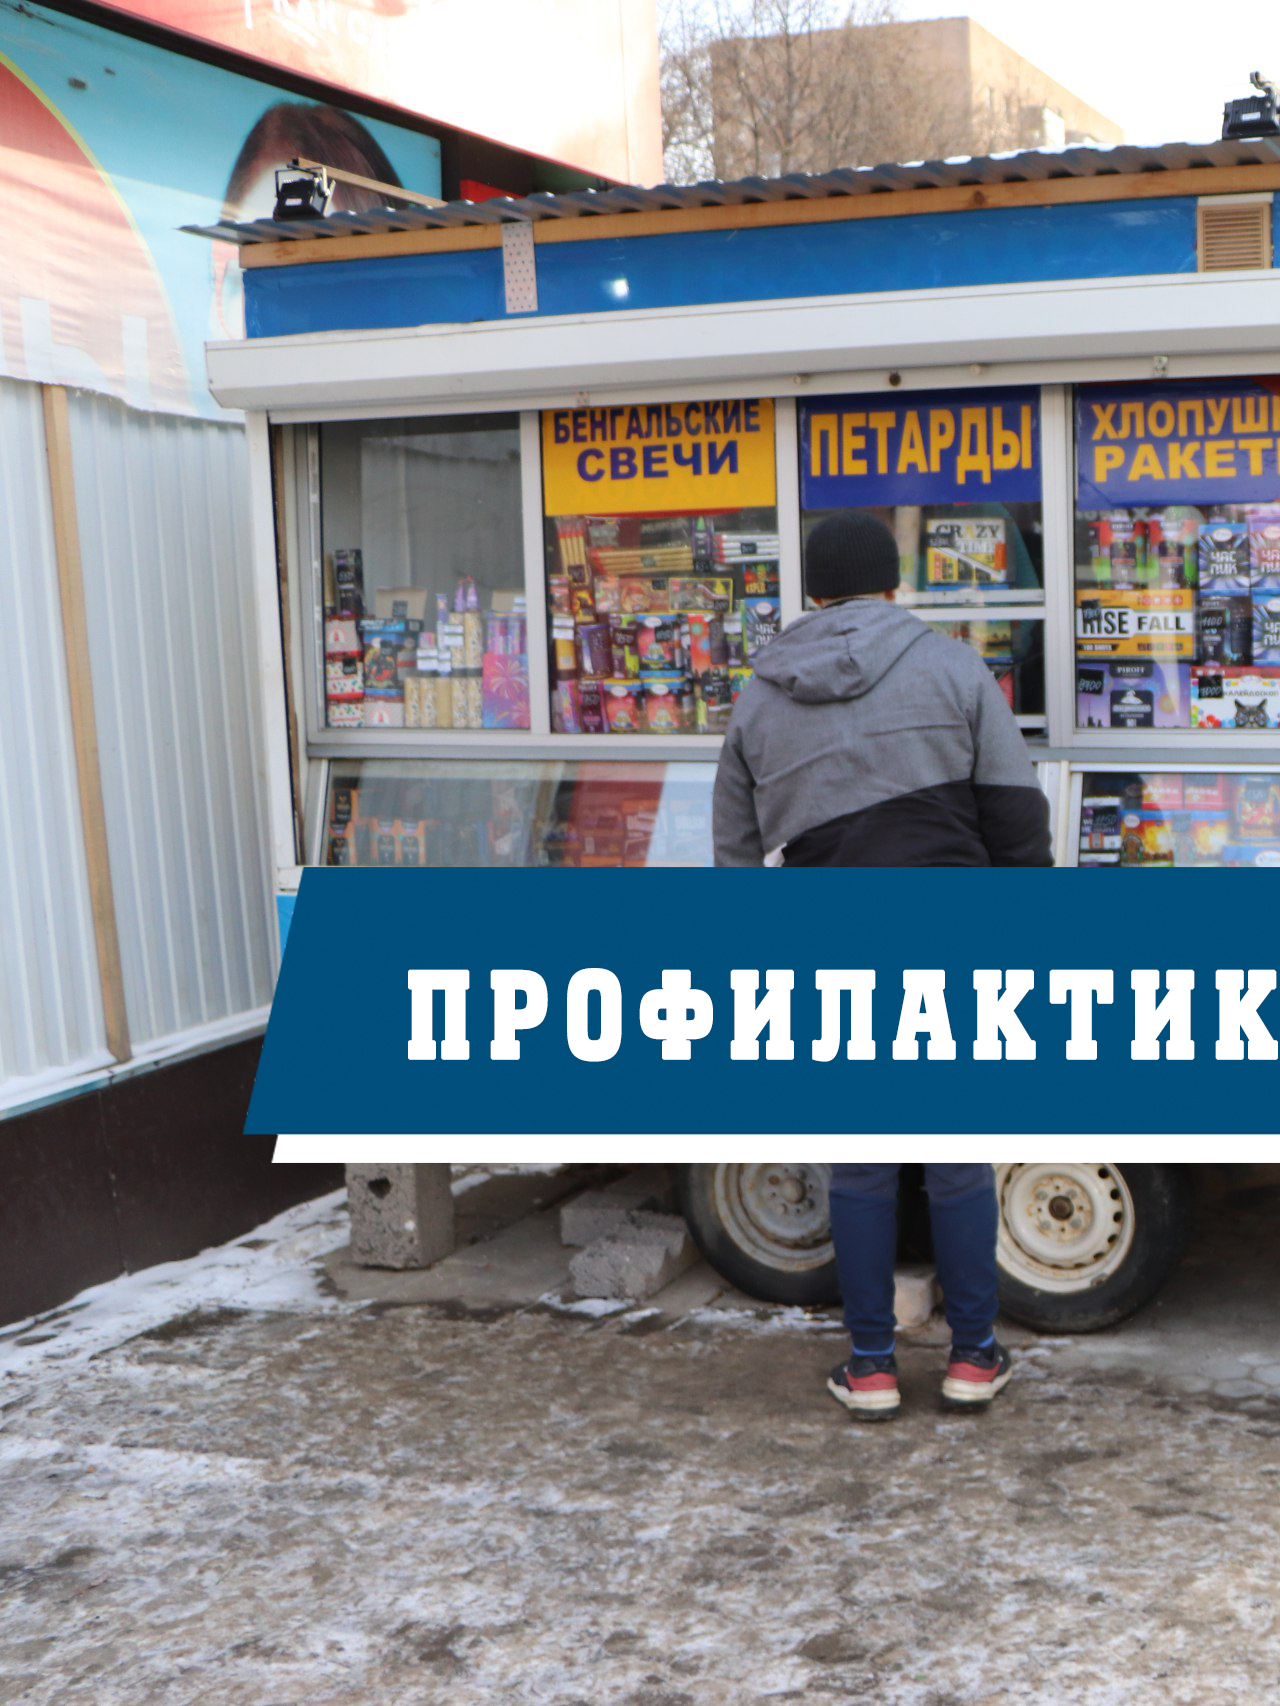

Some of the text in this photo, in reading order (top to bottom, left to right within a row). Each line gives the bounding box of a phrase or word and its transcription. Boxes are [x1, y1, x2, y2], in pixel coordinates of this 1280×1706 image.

[554, 400, 760, 444] БЕНГАЛЬСКИЕ
[811, 405, 1032, 484] ПЕТАРДЫ
[577, 441, 738, 482] СВЕЧИ
[936, 525, 999, 538] CRAZY
[1210, 552, 1236, 563] ЧАС
[1210, 564, 1238, 576] ПИК
[1138, 616, 1186, 631] FALL
